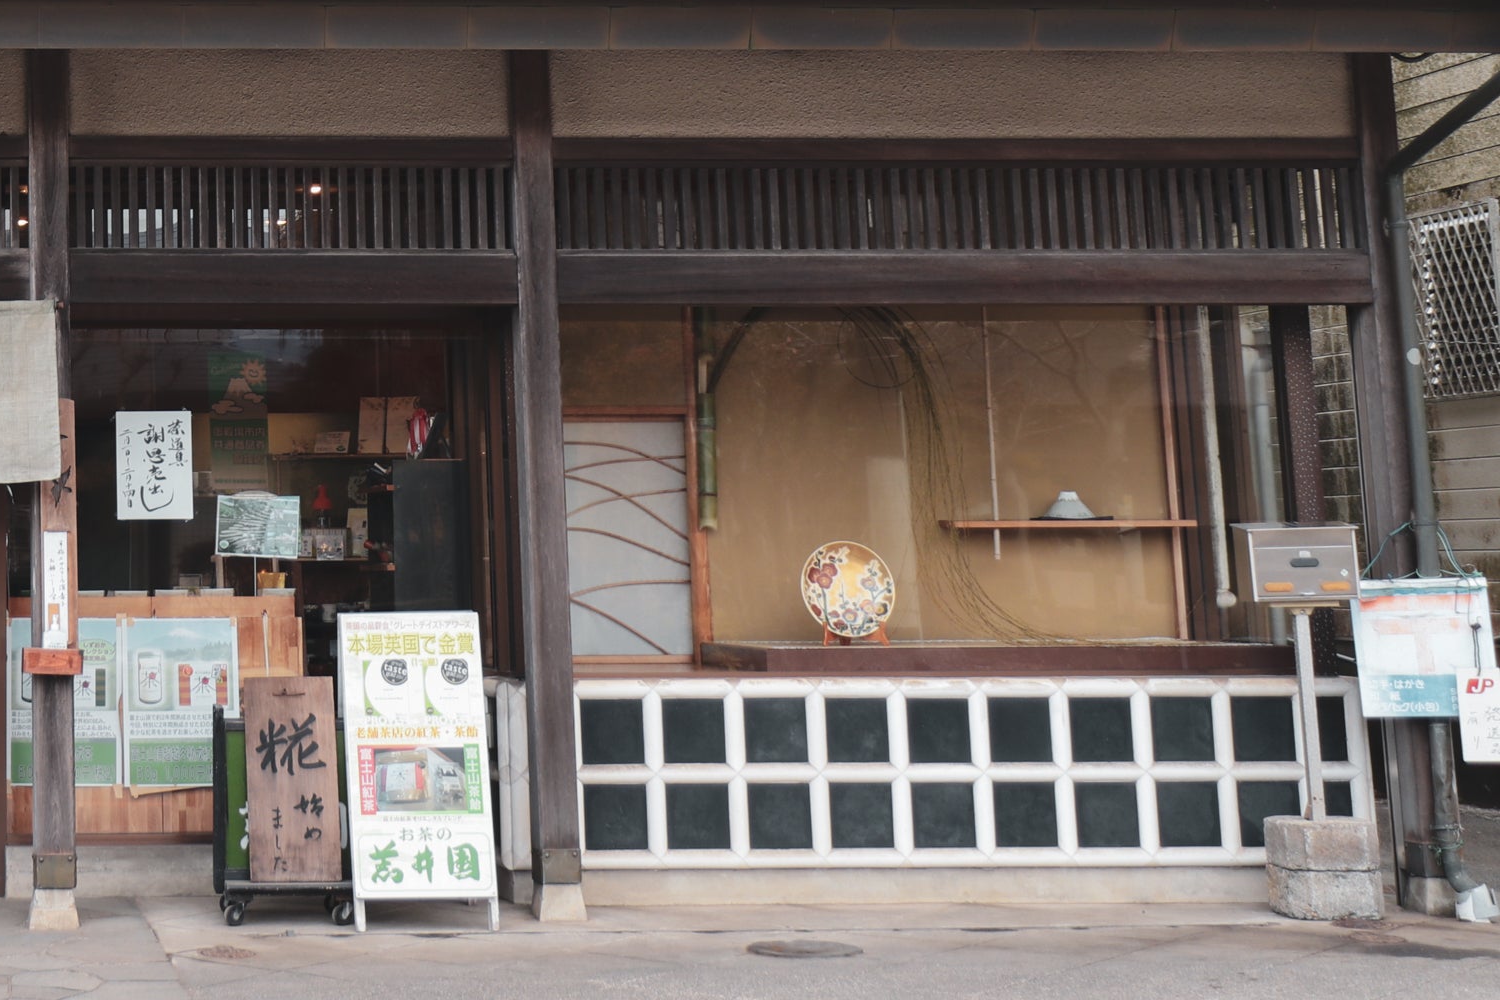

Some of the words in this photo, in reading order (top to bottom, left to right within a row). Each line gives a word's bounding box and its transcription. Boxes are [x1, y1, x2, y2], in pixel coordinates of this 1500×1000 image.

[347, 632, 475, 656] 本場英国で金賞
[255, 712, 326, 776] 糀
[359, 747, 375, 812] 富士山紅茶
[271, 806, 288, 872] ました
[399, 826, 452, 842] お茶の
[368, 840, 481, 884] 荒井園
